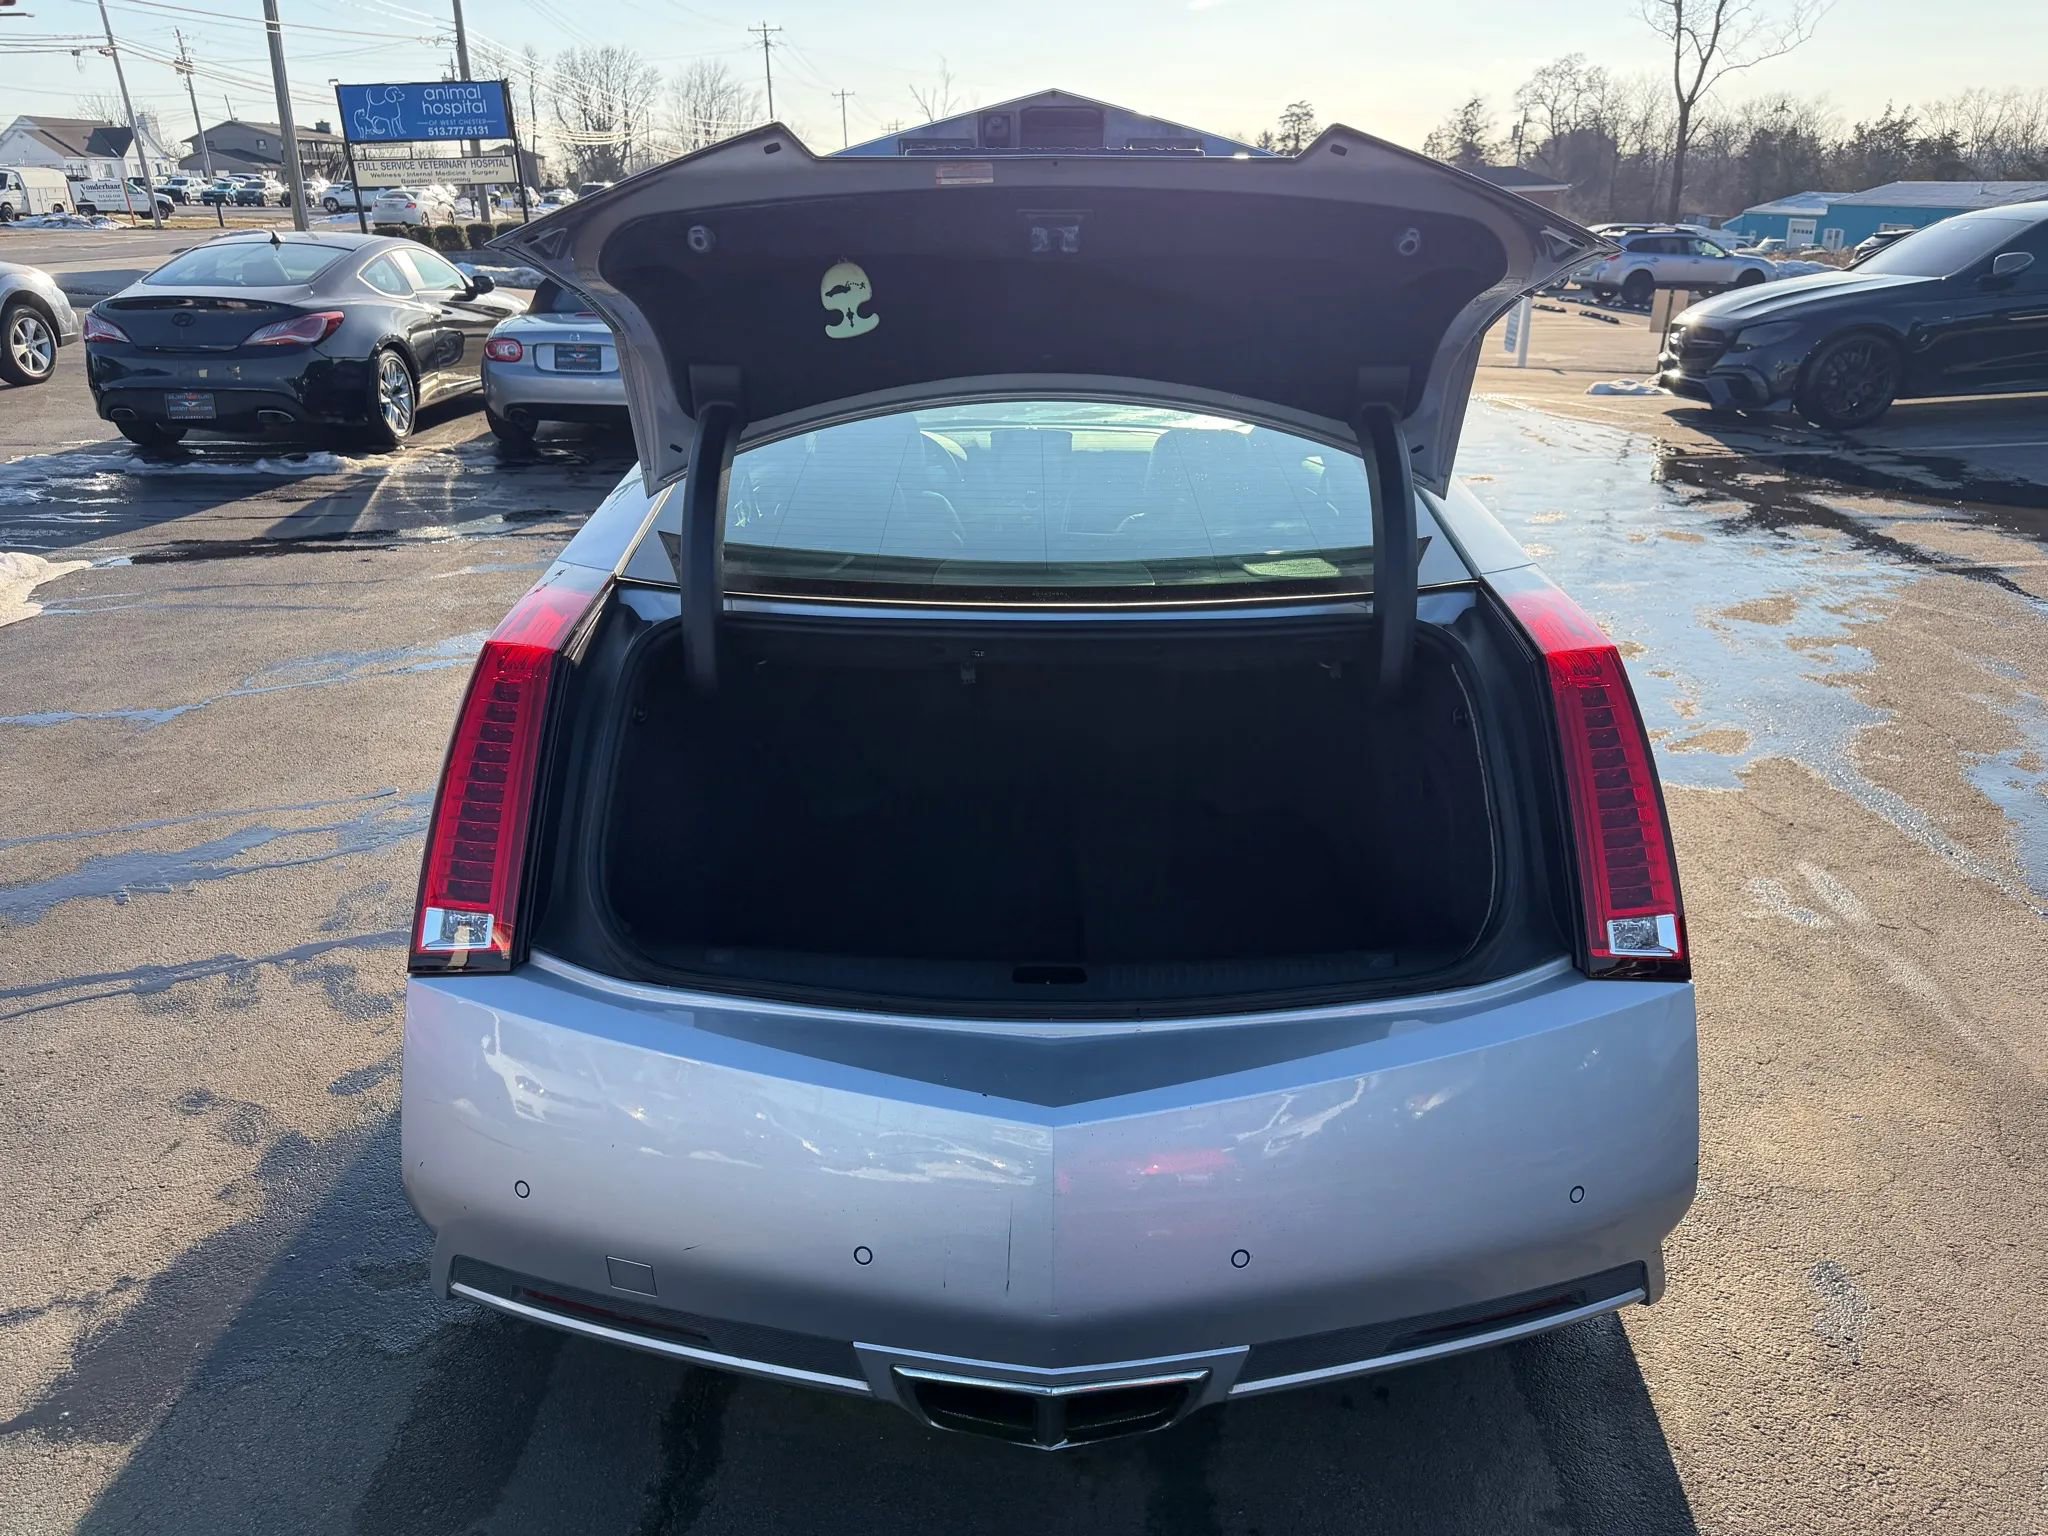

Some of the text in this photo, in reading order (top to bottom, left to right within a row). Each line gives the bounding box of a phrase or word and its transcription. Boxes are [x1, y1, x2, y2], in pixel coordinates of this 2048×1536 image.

[424, 85, 481, 100] animal
[422, 99, 487, 117] hospital
[428, 126, 489, 136] 513.777.5131
[357, 158, 509, 171] FULL SERVICE VETERINARY HOSPITAL
